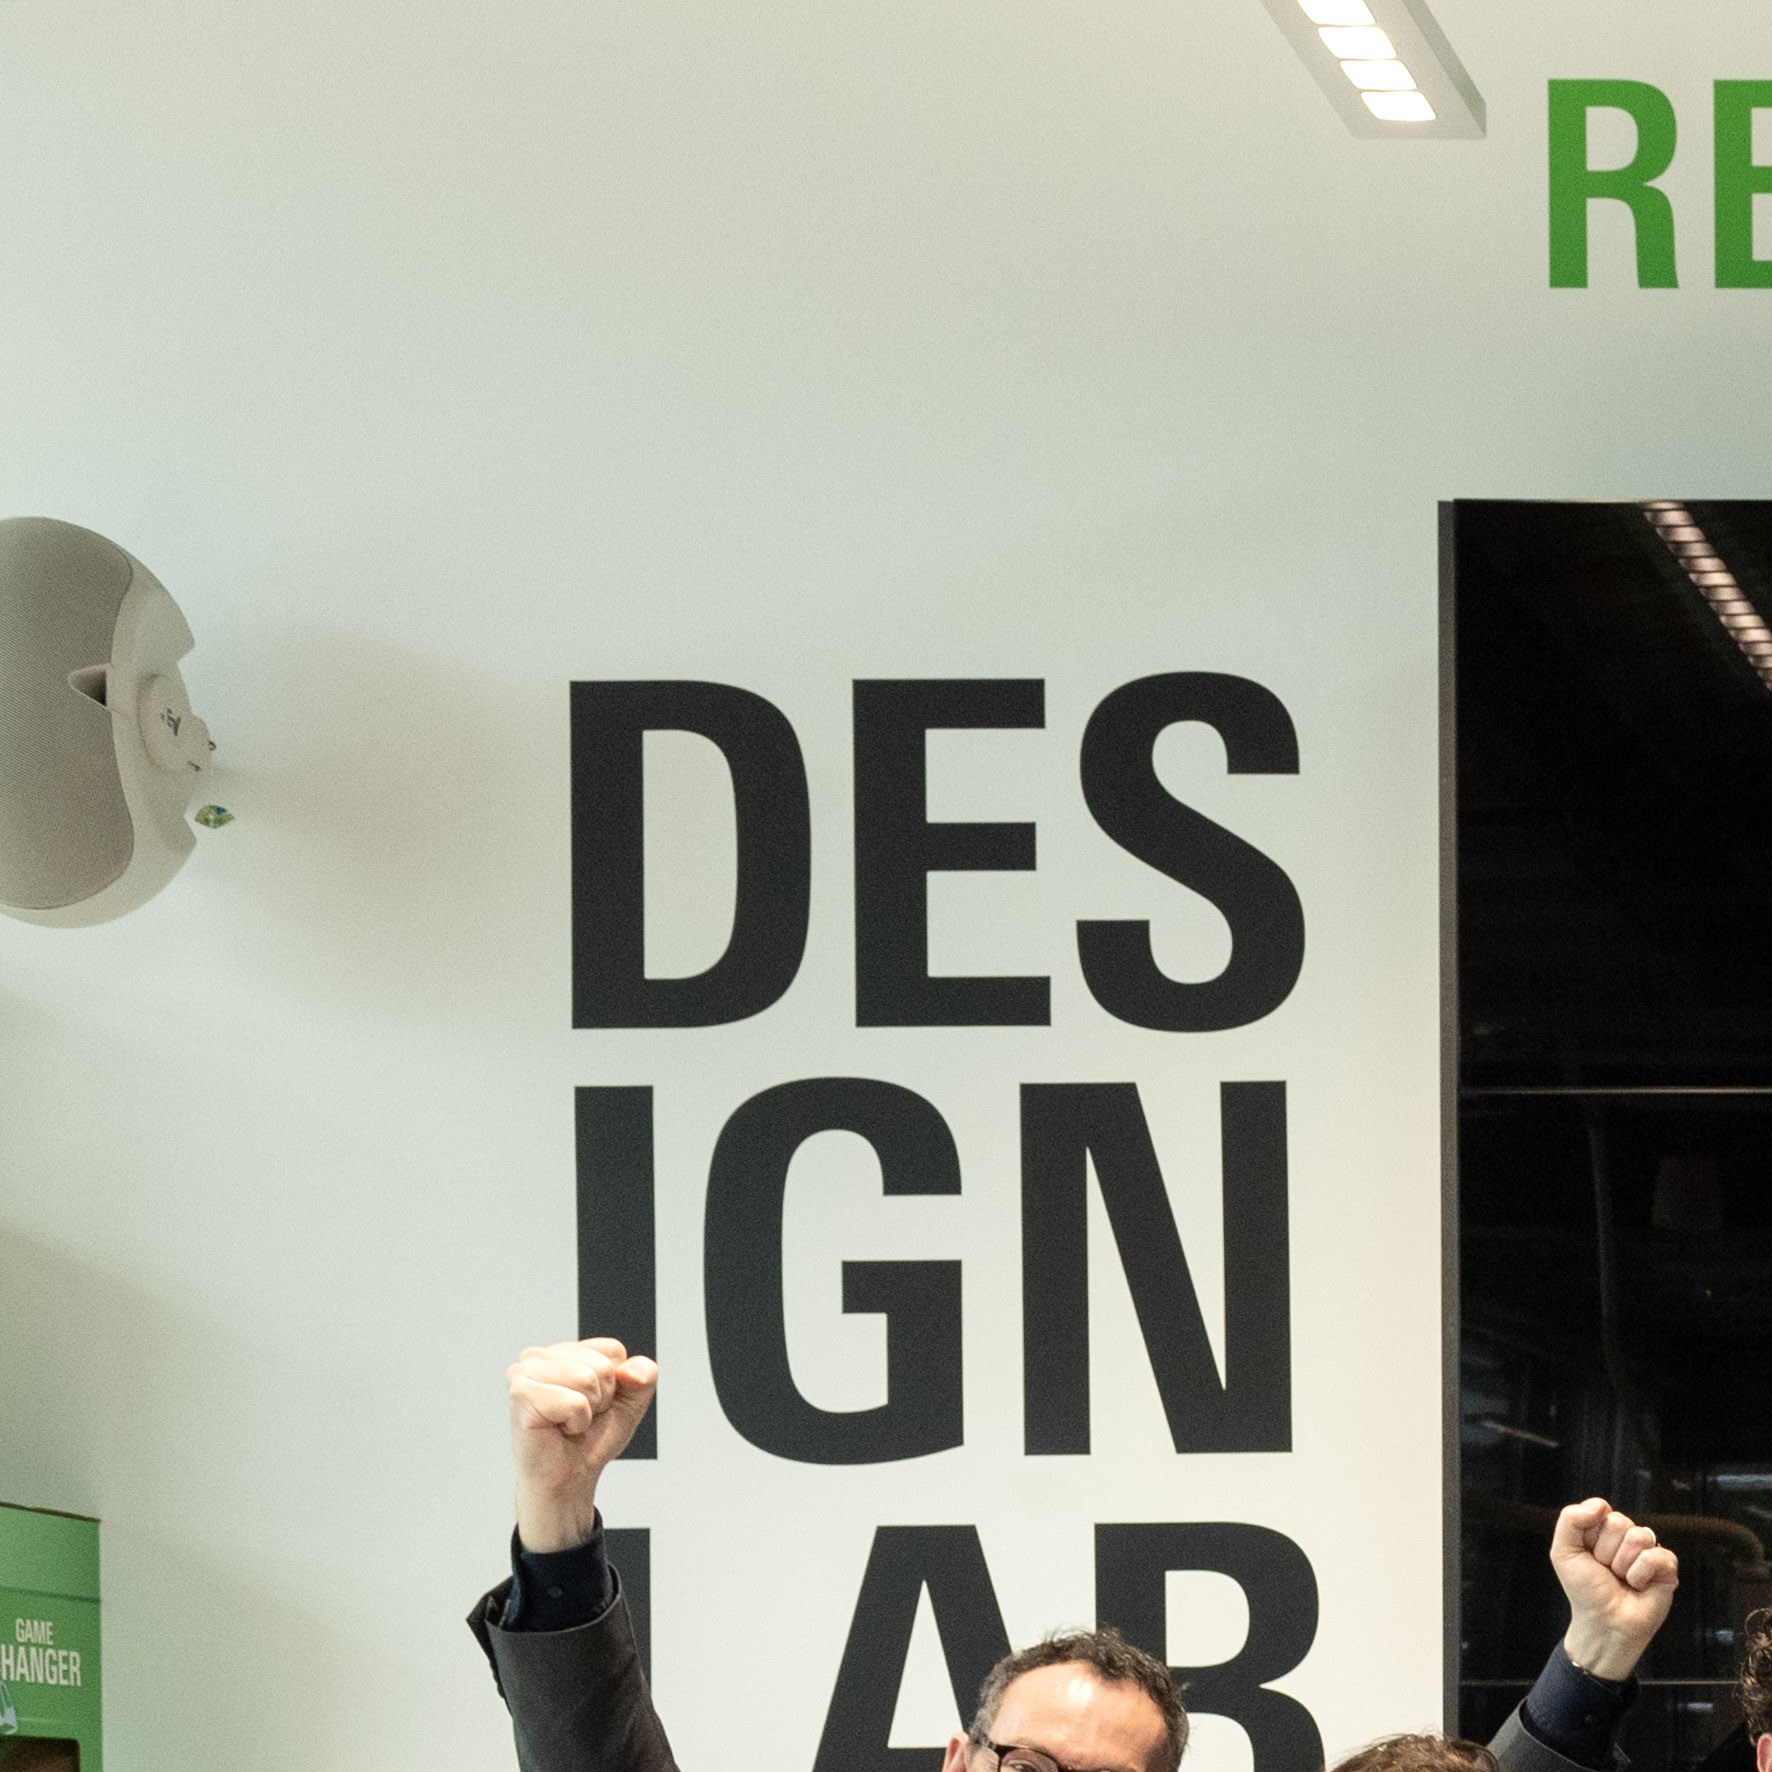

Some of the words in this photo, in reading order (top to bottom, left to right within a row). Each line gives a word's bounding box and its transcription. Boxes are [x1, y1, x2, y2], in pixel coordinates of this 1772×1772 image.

[570, 671, 1306, 1034] DES
[574, 1075, 1294, 1466] IGN
[0, 1643, 82, 1687] HANGER
[16, 1618, 53, 1645] GAME
